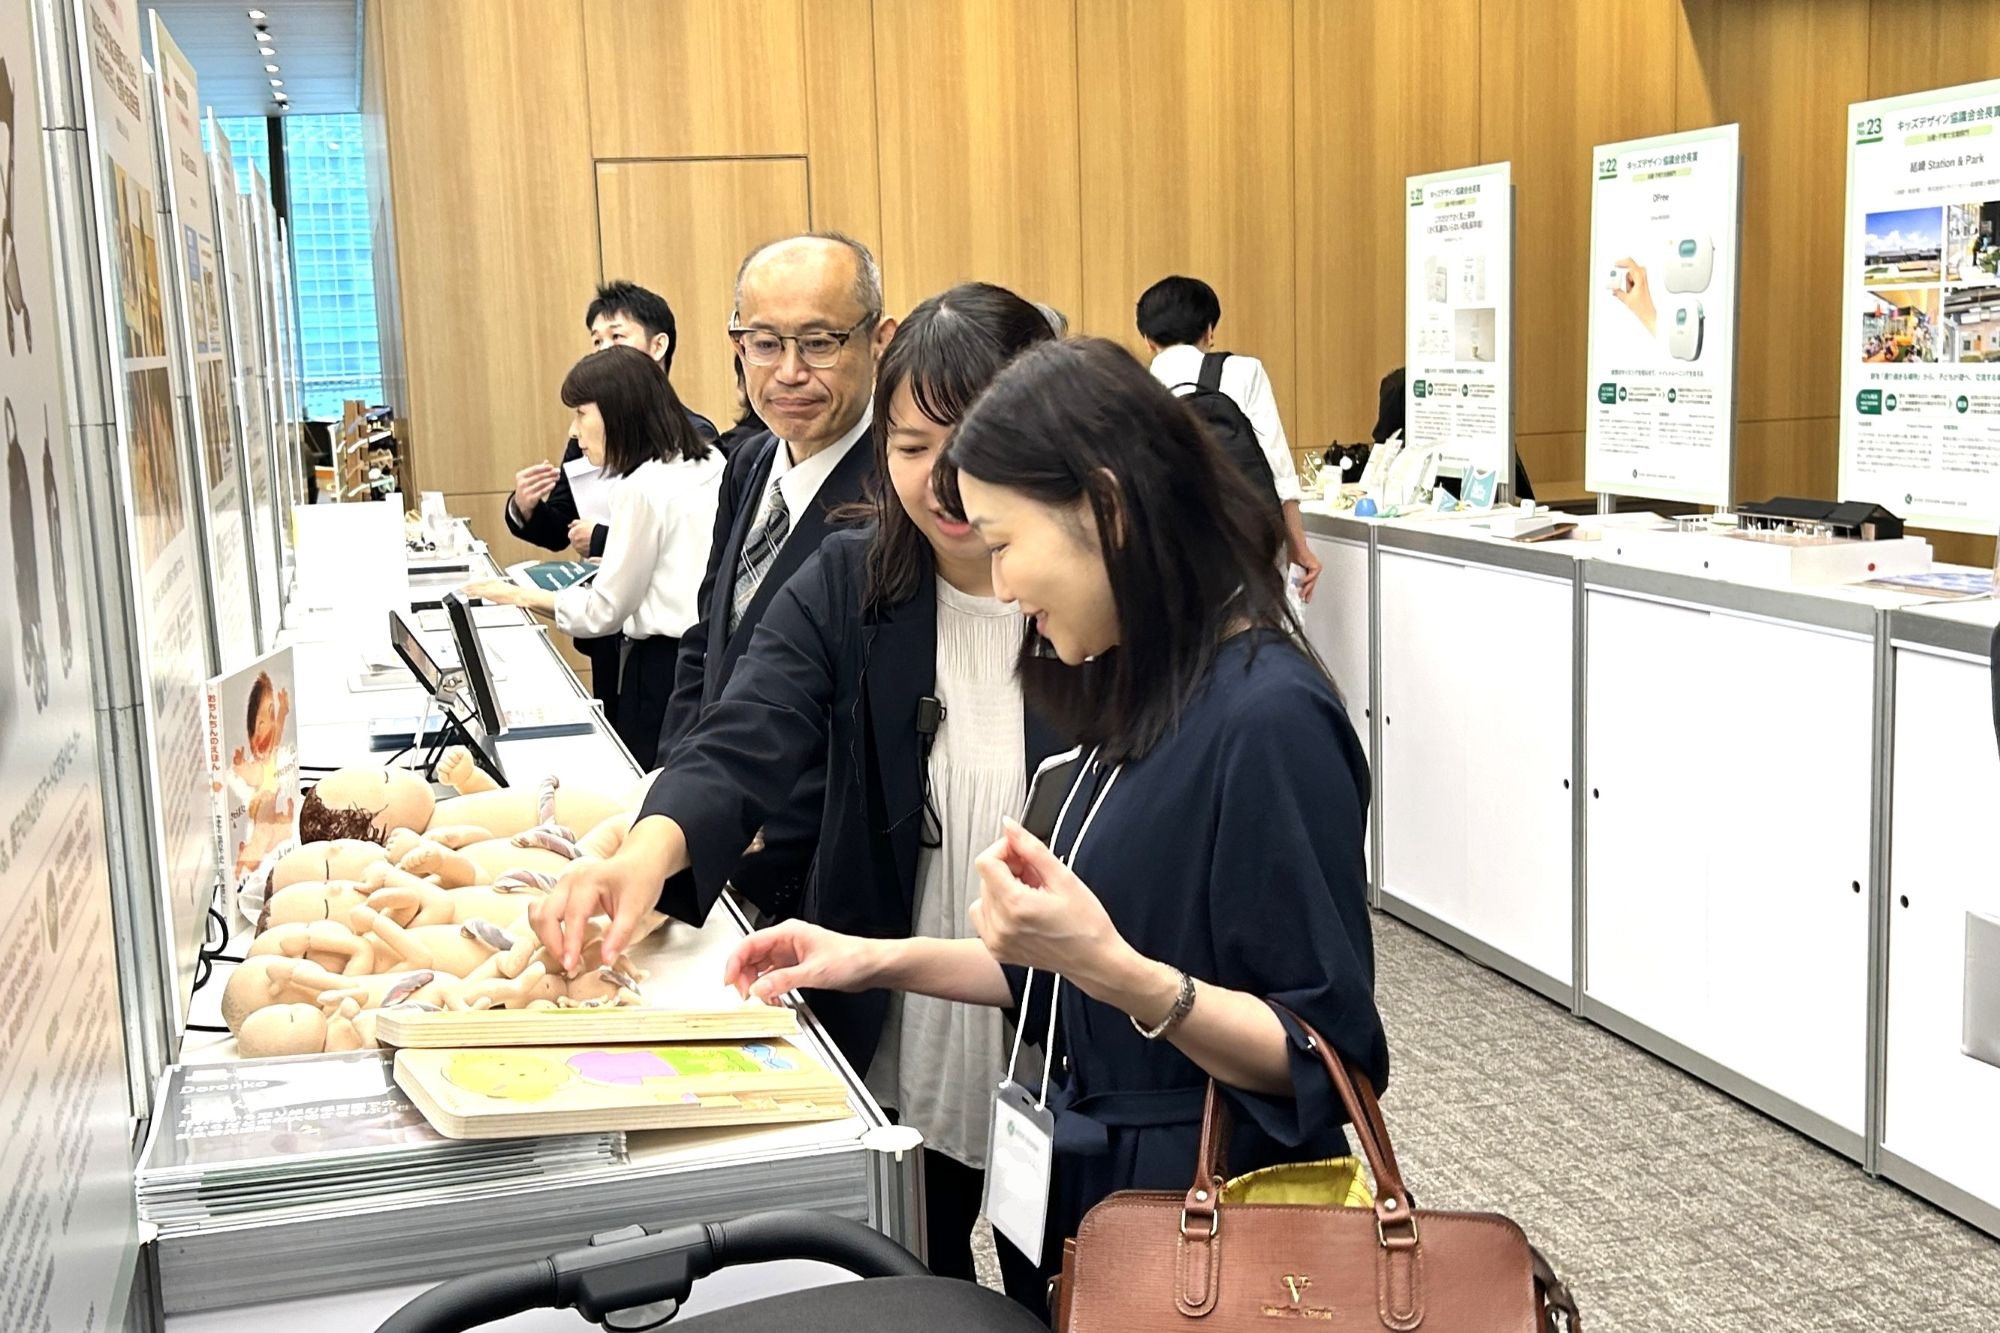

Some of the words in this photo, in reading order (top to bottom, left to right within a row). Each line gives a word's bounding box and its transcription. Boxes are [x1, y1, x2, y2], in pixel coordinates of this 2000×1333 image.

[1866, 118, 1882, 136] 23
[1606, 158, 1617, 173] 22
[1928, 157, 1955, 170] Station
[1957, 156, 1963, 166] &
[1965, 153, 1984, 165] Park
[208, 694, 220, 771] おちんちんのえほん
[180, 1080, 269, 1095] Doronko
